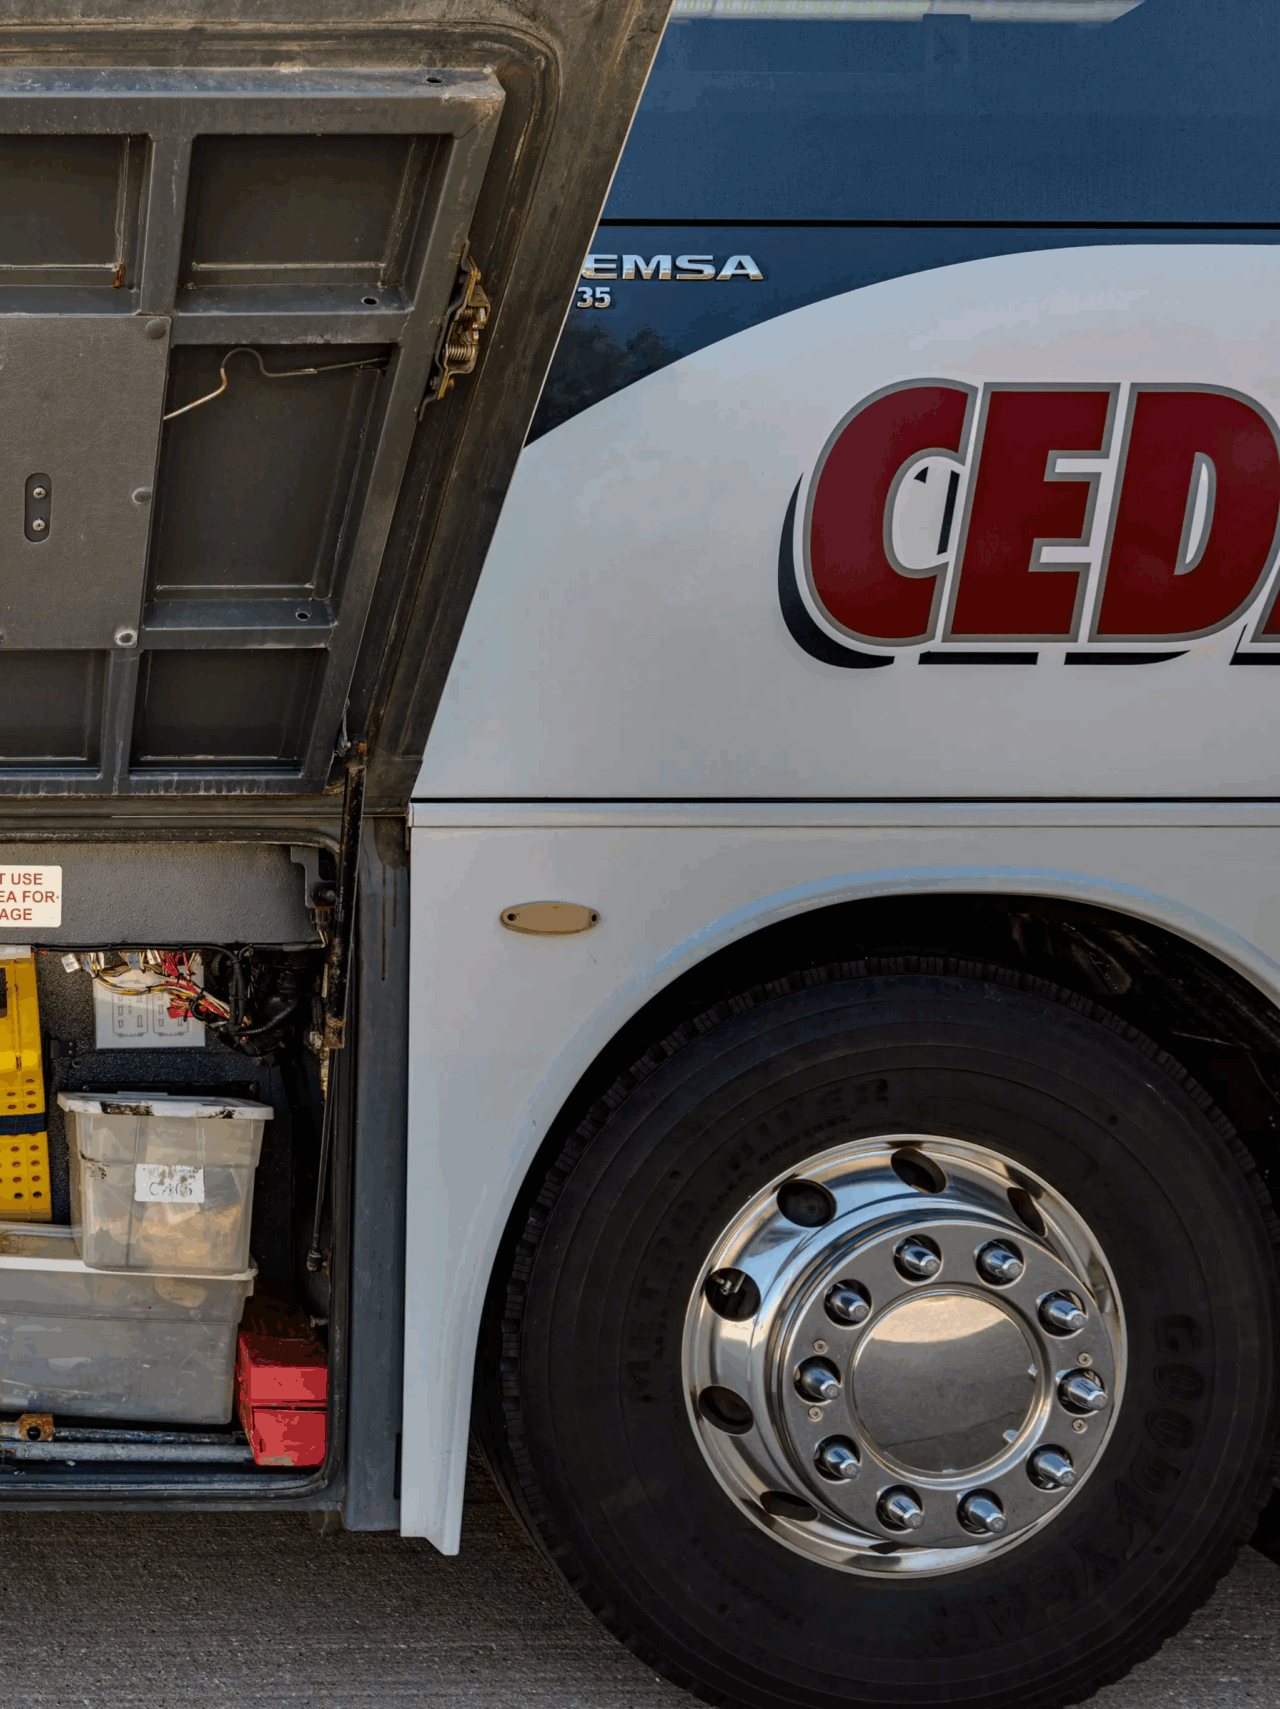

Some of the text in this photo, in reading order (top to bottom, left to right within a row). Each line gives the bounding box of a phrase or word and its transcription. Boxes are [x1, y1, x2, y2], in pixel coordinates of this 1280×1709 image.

[577, 286, 611, 308] 35
[801, 377, 1280, 649] CED
[11, 872, 43, 885] USE
[22, 891, 55, 903] FOR
